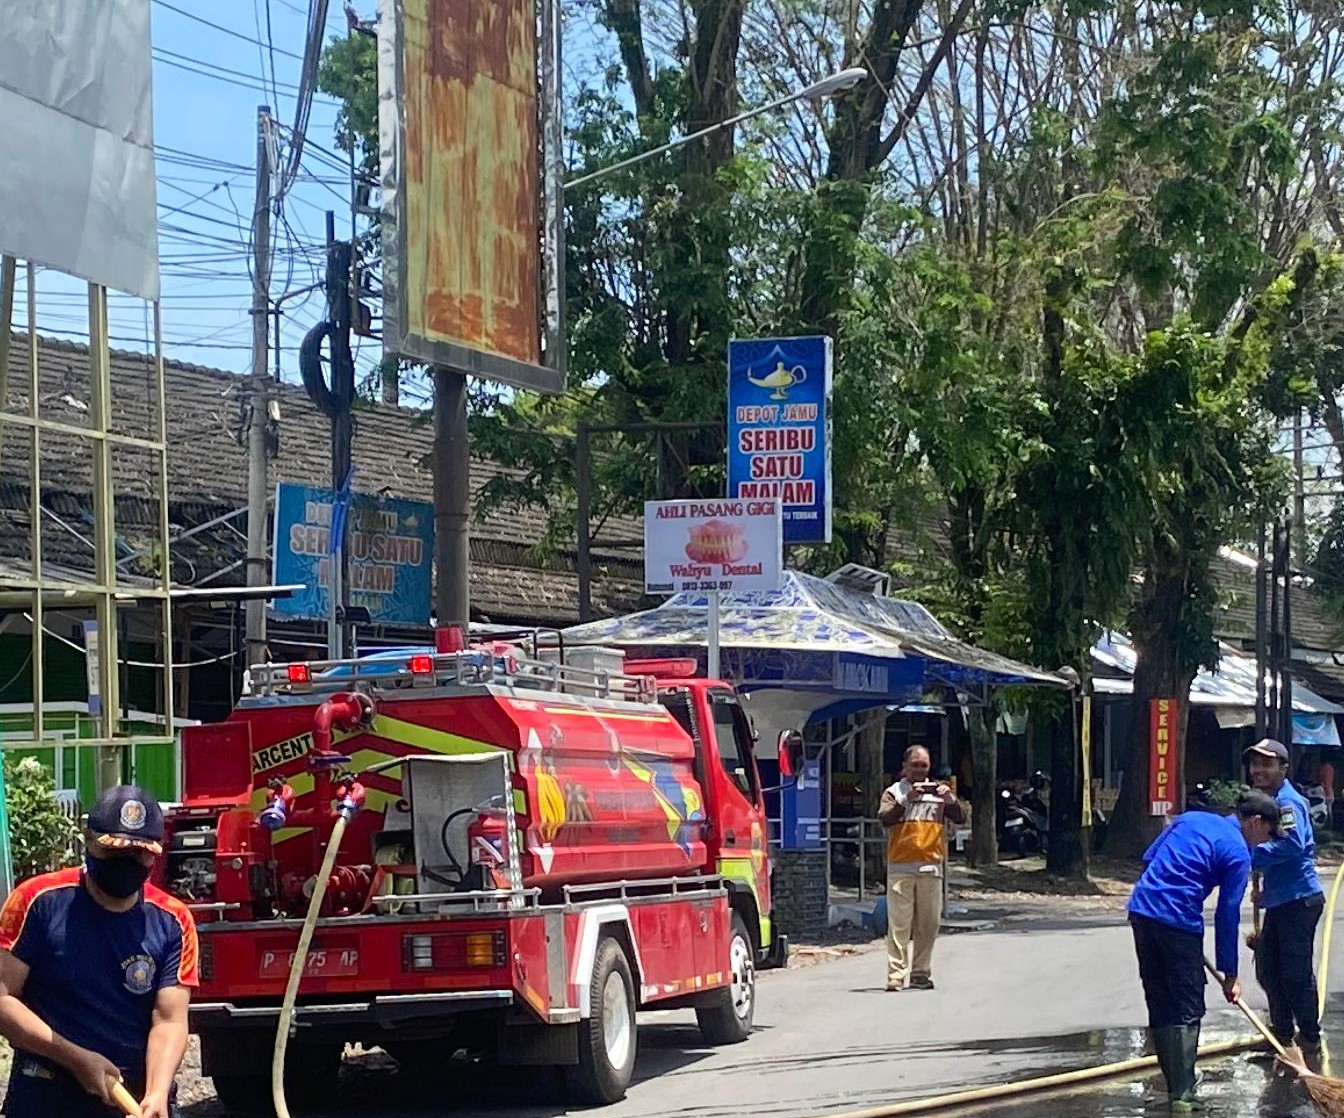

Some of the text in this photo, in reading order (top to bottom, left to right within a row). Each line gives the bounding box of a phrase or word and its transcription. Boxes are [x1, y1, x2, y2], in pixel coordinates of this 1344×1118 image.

[737, 404, 818, 423] DEPOT JAMU
[739, 427, 814, 453] SERIBU
[751, 455, 803, 479] SATU
[656, 505, 686, 519] AHLI
[690, 502, 743, 518] PASANG
[746, 501, 775, 516] GIGI
[371, 534, 423, 567] SATU
[669, 562, 763, 580] Wahyu Dental
[1157, 699, 1169, 799] SERVICE
[263, 953, 274, 968] P
